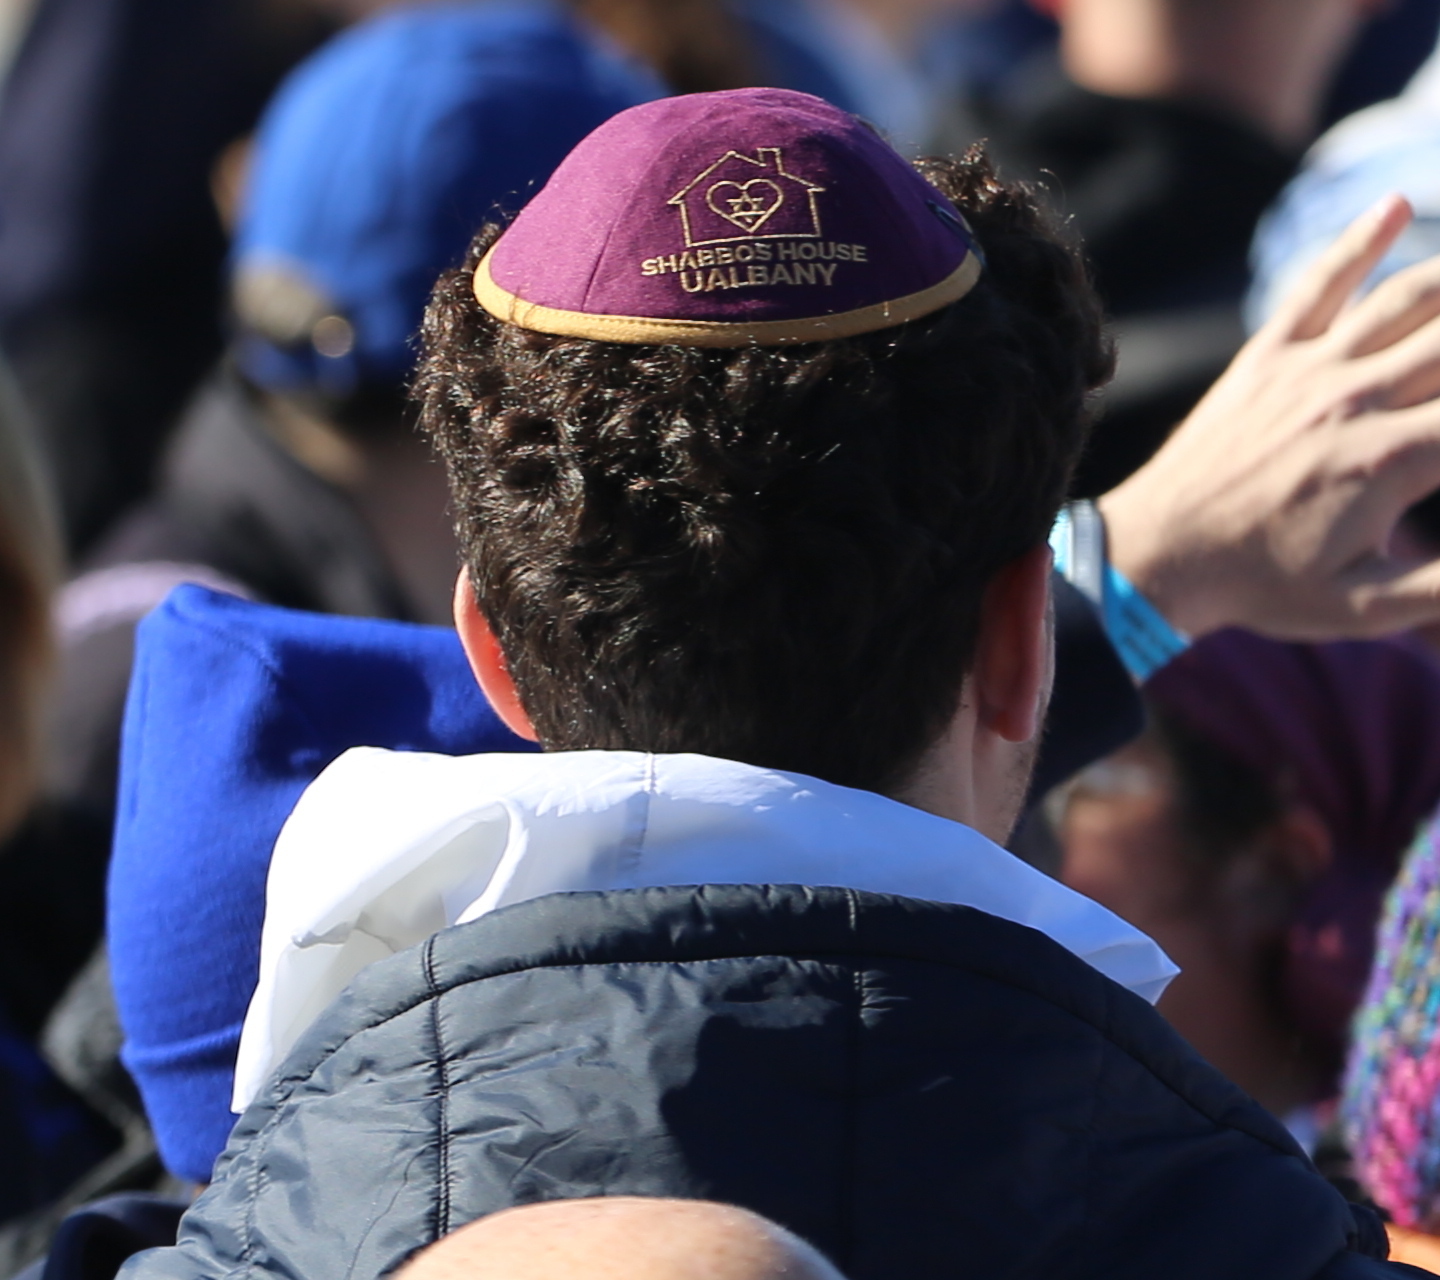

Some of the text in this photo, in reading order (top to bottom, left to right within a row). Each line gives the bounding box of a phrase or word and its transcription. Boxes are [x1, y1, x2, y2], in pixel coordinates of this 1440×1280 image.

[641, 241, 868, 276] SHABBOS HOUSE
[680, 263, 838, 293] UALBANY
